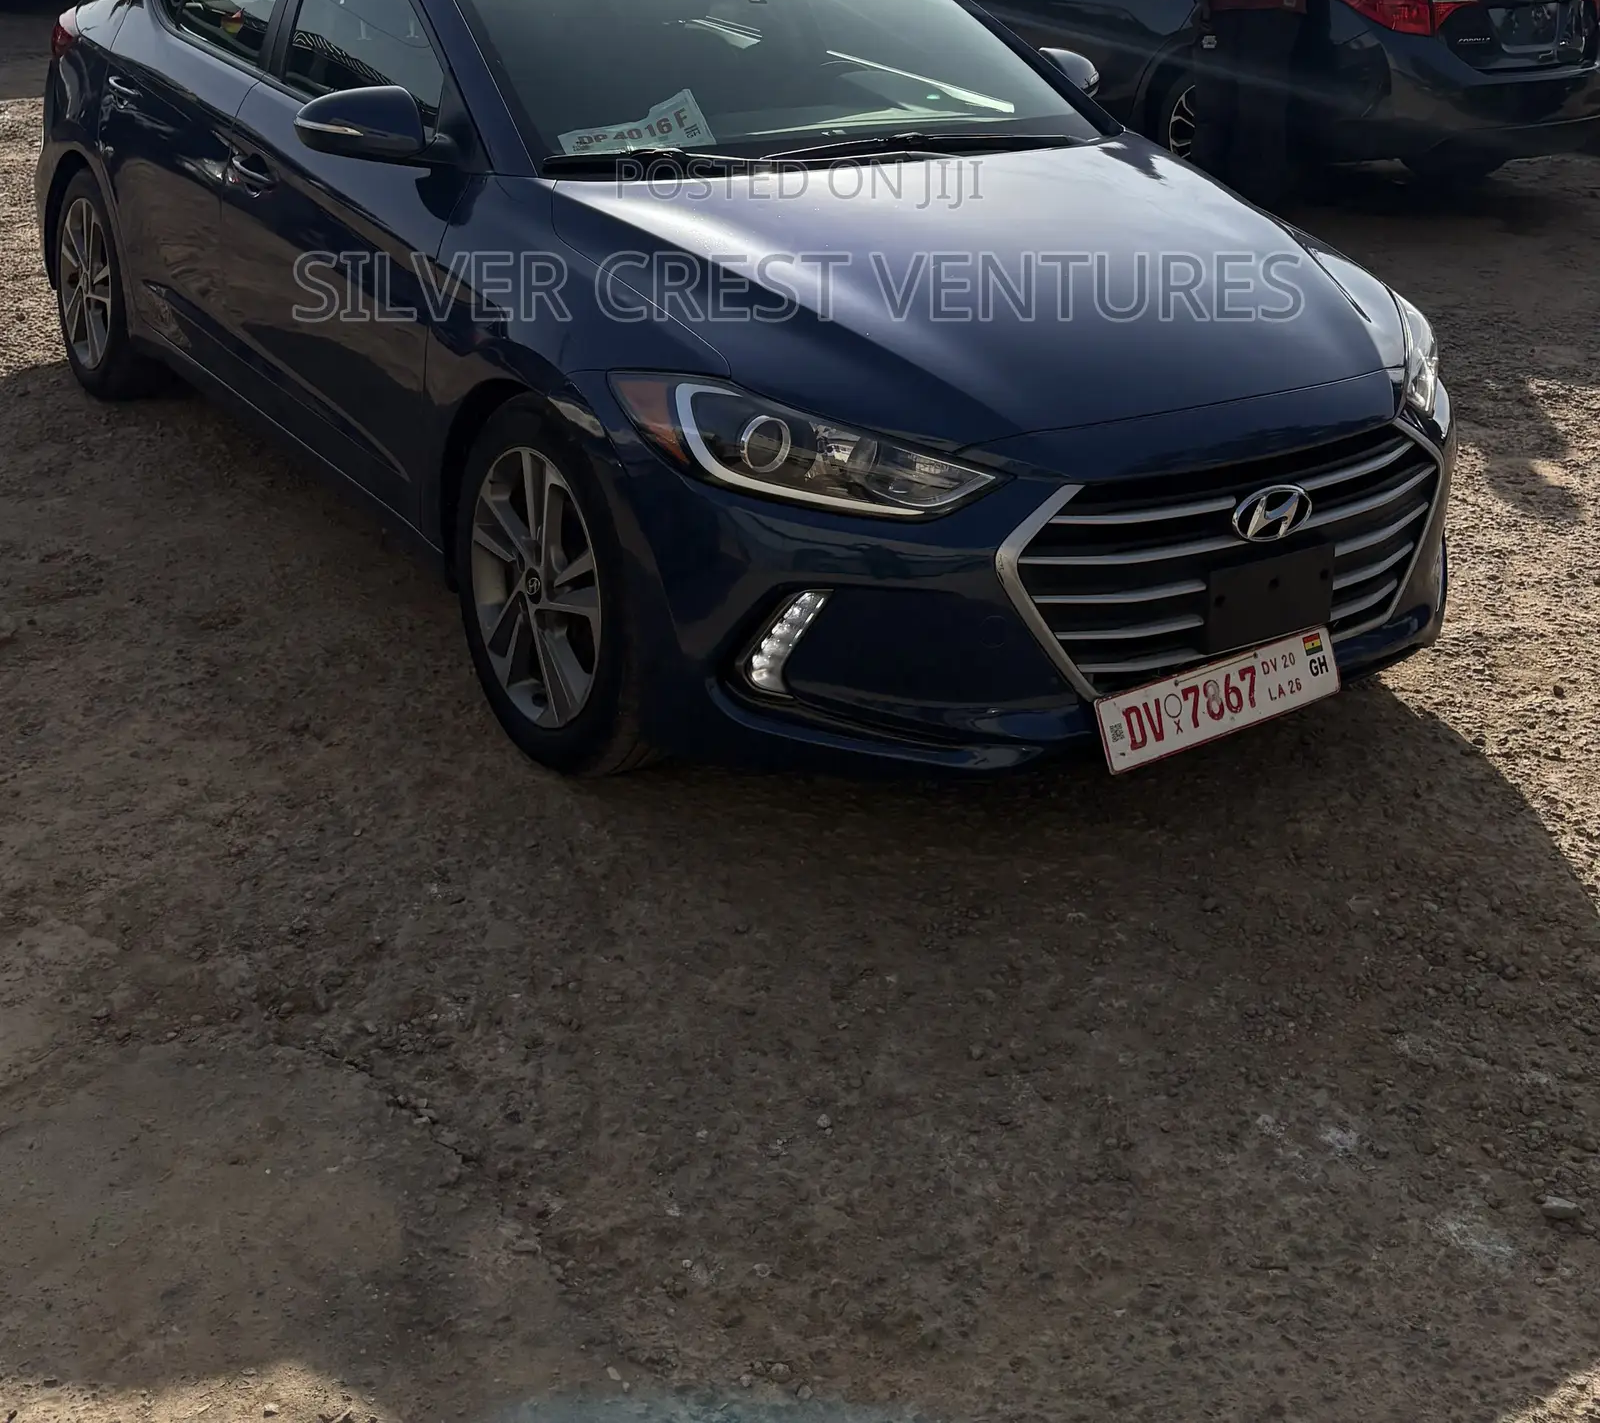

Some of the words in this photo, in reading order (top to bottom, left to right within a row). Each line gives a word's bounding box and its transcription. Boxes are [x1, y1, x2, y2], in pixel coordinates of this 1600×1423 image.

[673, 108, 690, 129] F
[1261, 657, 1278, 675] DV
[1281, 652, 1296, 669] 20
[1309, 655, 1329, 677] GH
[1268, 683, 1286, 701] LA
[1287, 677, 1303, 695] 26
[1122, 698, 1164, 750] DV
[1181, 665, 1257, 728] 7867
